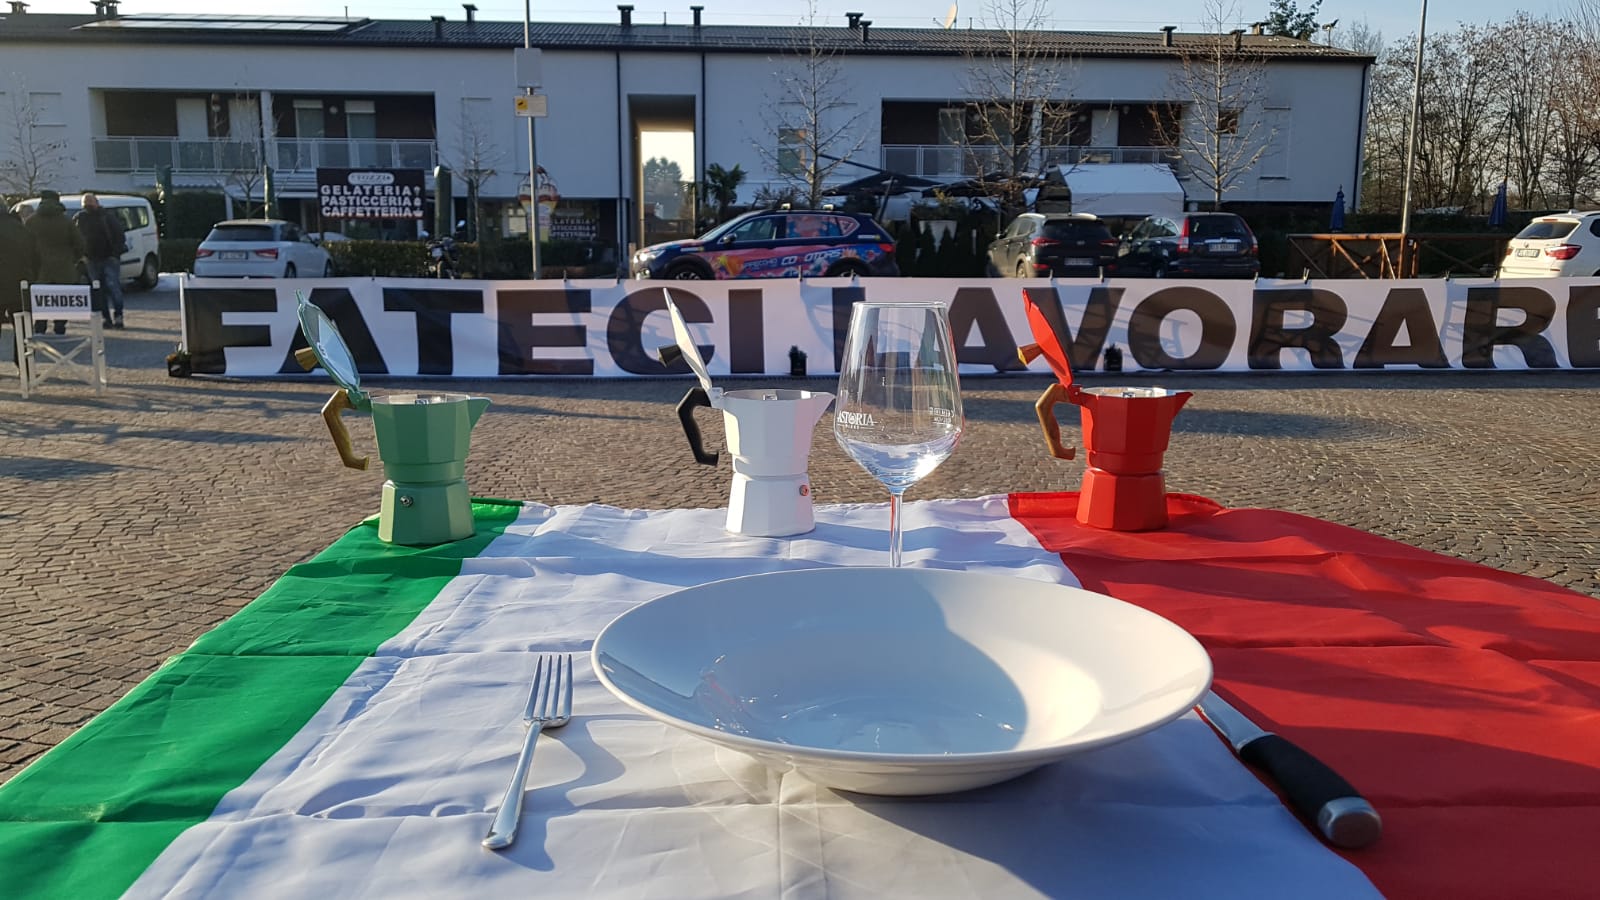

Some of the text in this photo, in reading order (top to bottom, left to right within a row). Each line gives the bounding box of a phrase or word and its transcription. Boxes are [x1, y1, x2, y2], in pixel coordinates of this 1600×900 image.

[320, 185, 412, 196] GELATERIA
[321, 195, 412, 206] PASTICCERIA
[321, 206, 413, 217] CAFFETTERIA
[35, 294, 89, 308] VENDESI
[183, 285, 765, 376] FATECI
[837, 410, 876, 427] ASTORIA
